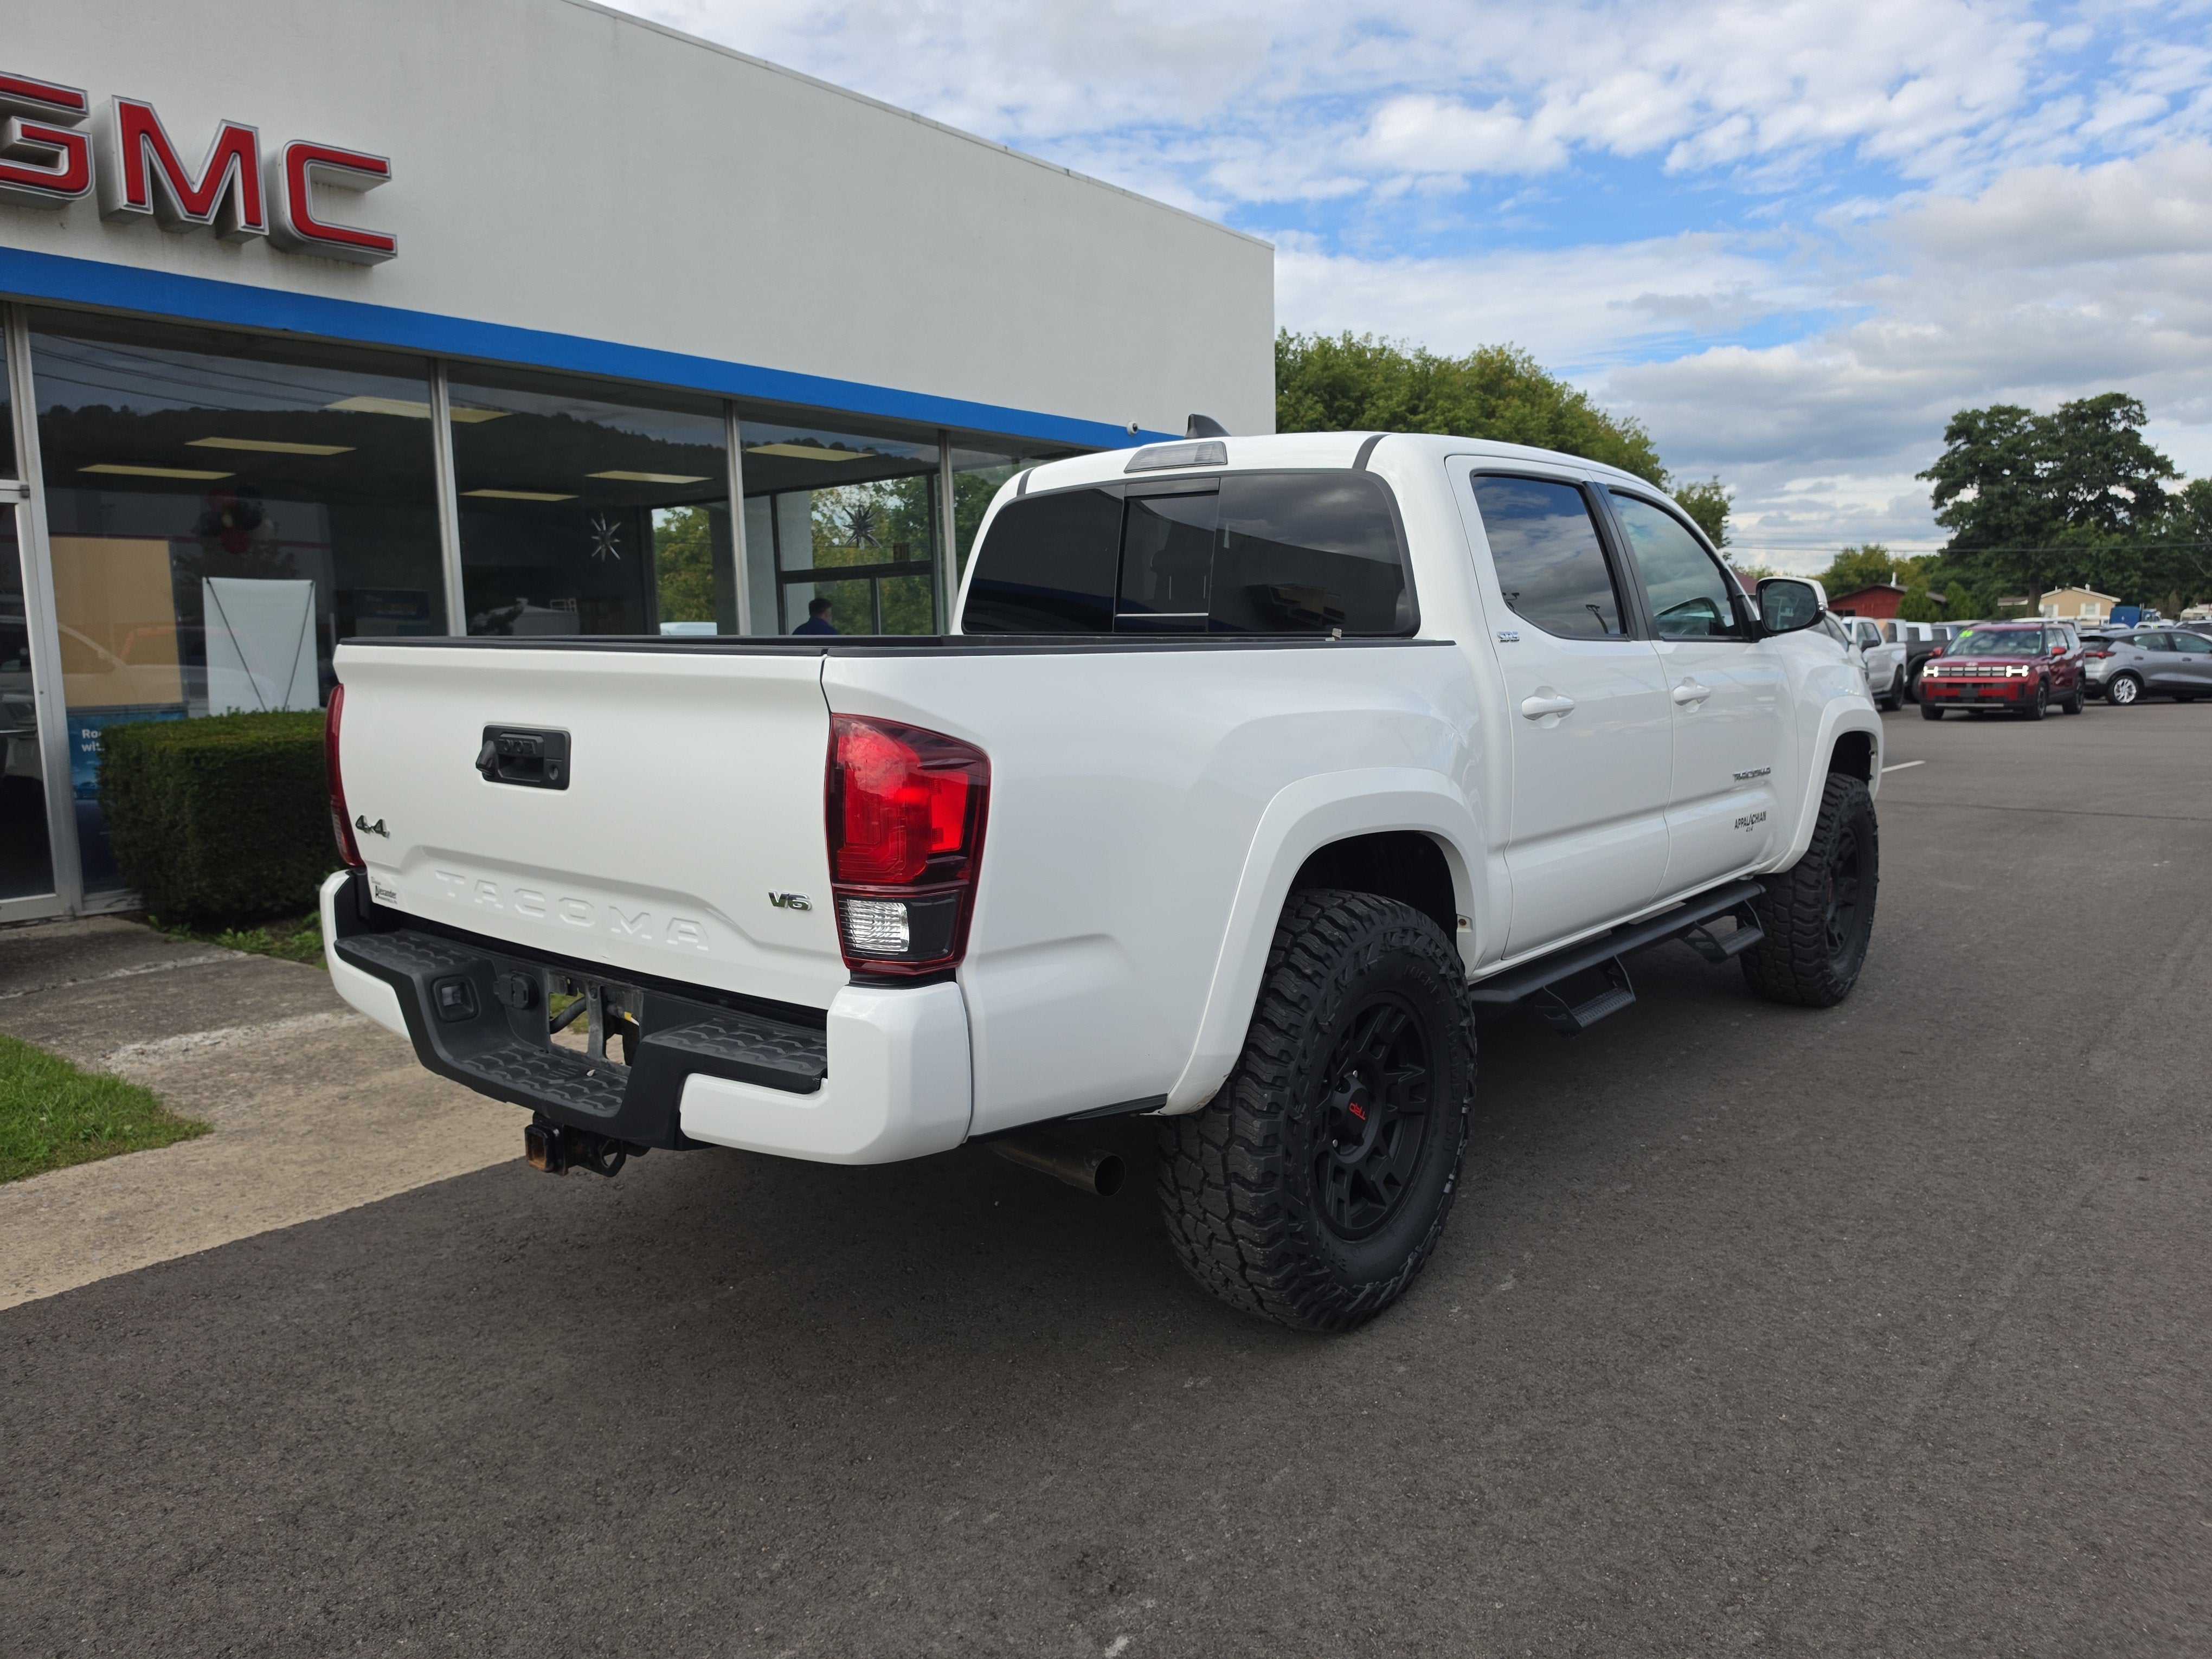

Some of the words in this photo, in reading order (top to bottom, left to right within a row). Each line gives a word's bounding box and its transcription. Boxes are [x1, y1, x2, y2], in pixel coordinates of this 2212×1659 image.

[0, 71, 398, 261] GMC
[82, 729, 102, 739] Ro
[498, 738, 537, 755] TOYOTA
[435, 870, 709, 950] TACOMA
[768, 890, 813, 911] V6
[1349, 1102, 1366, 1121] TRD
